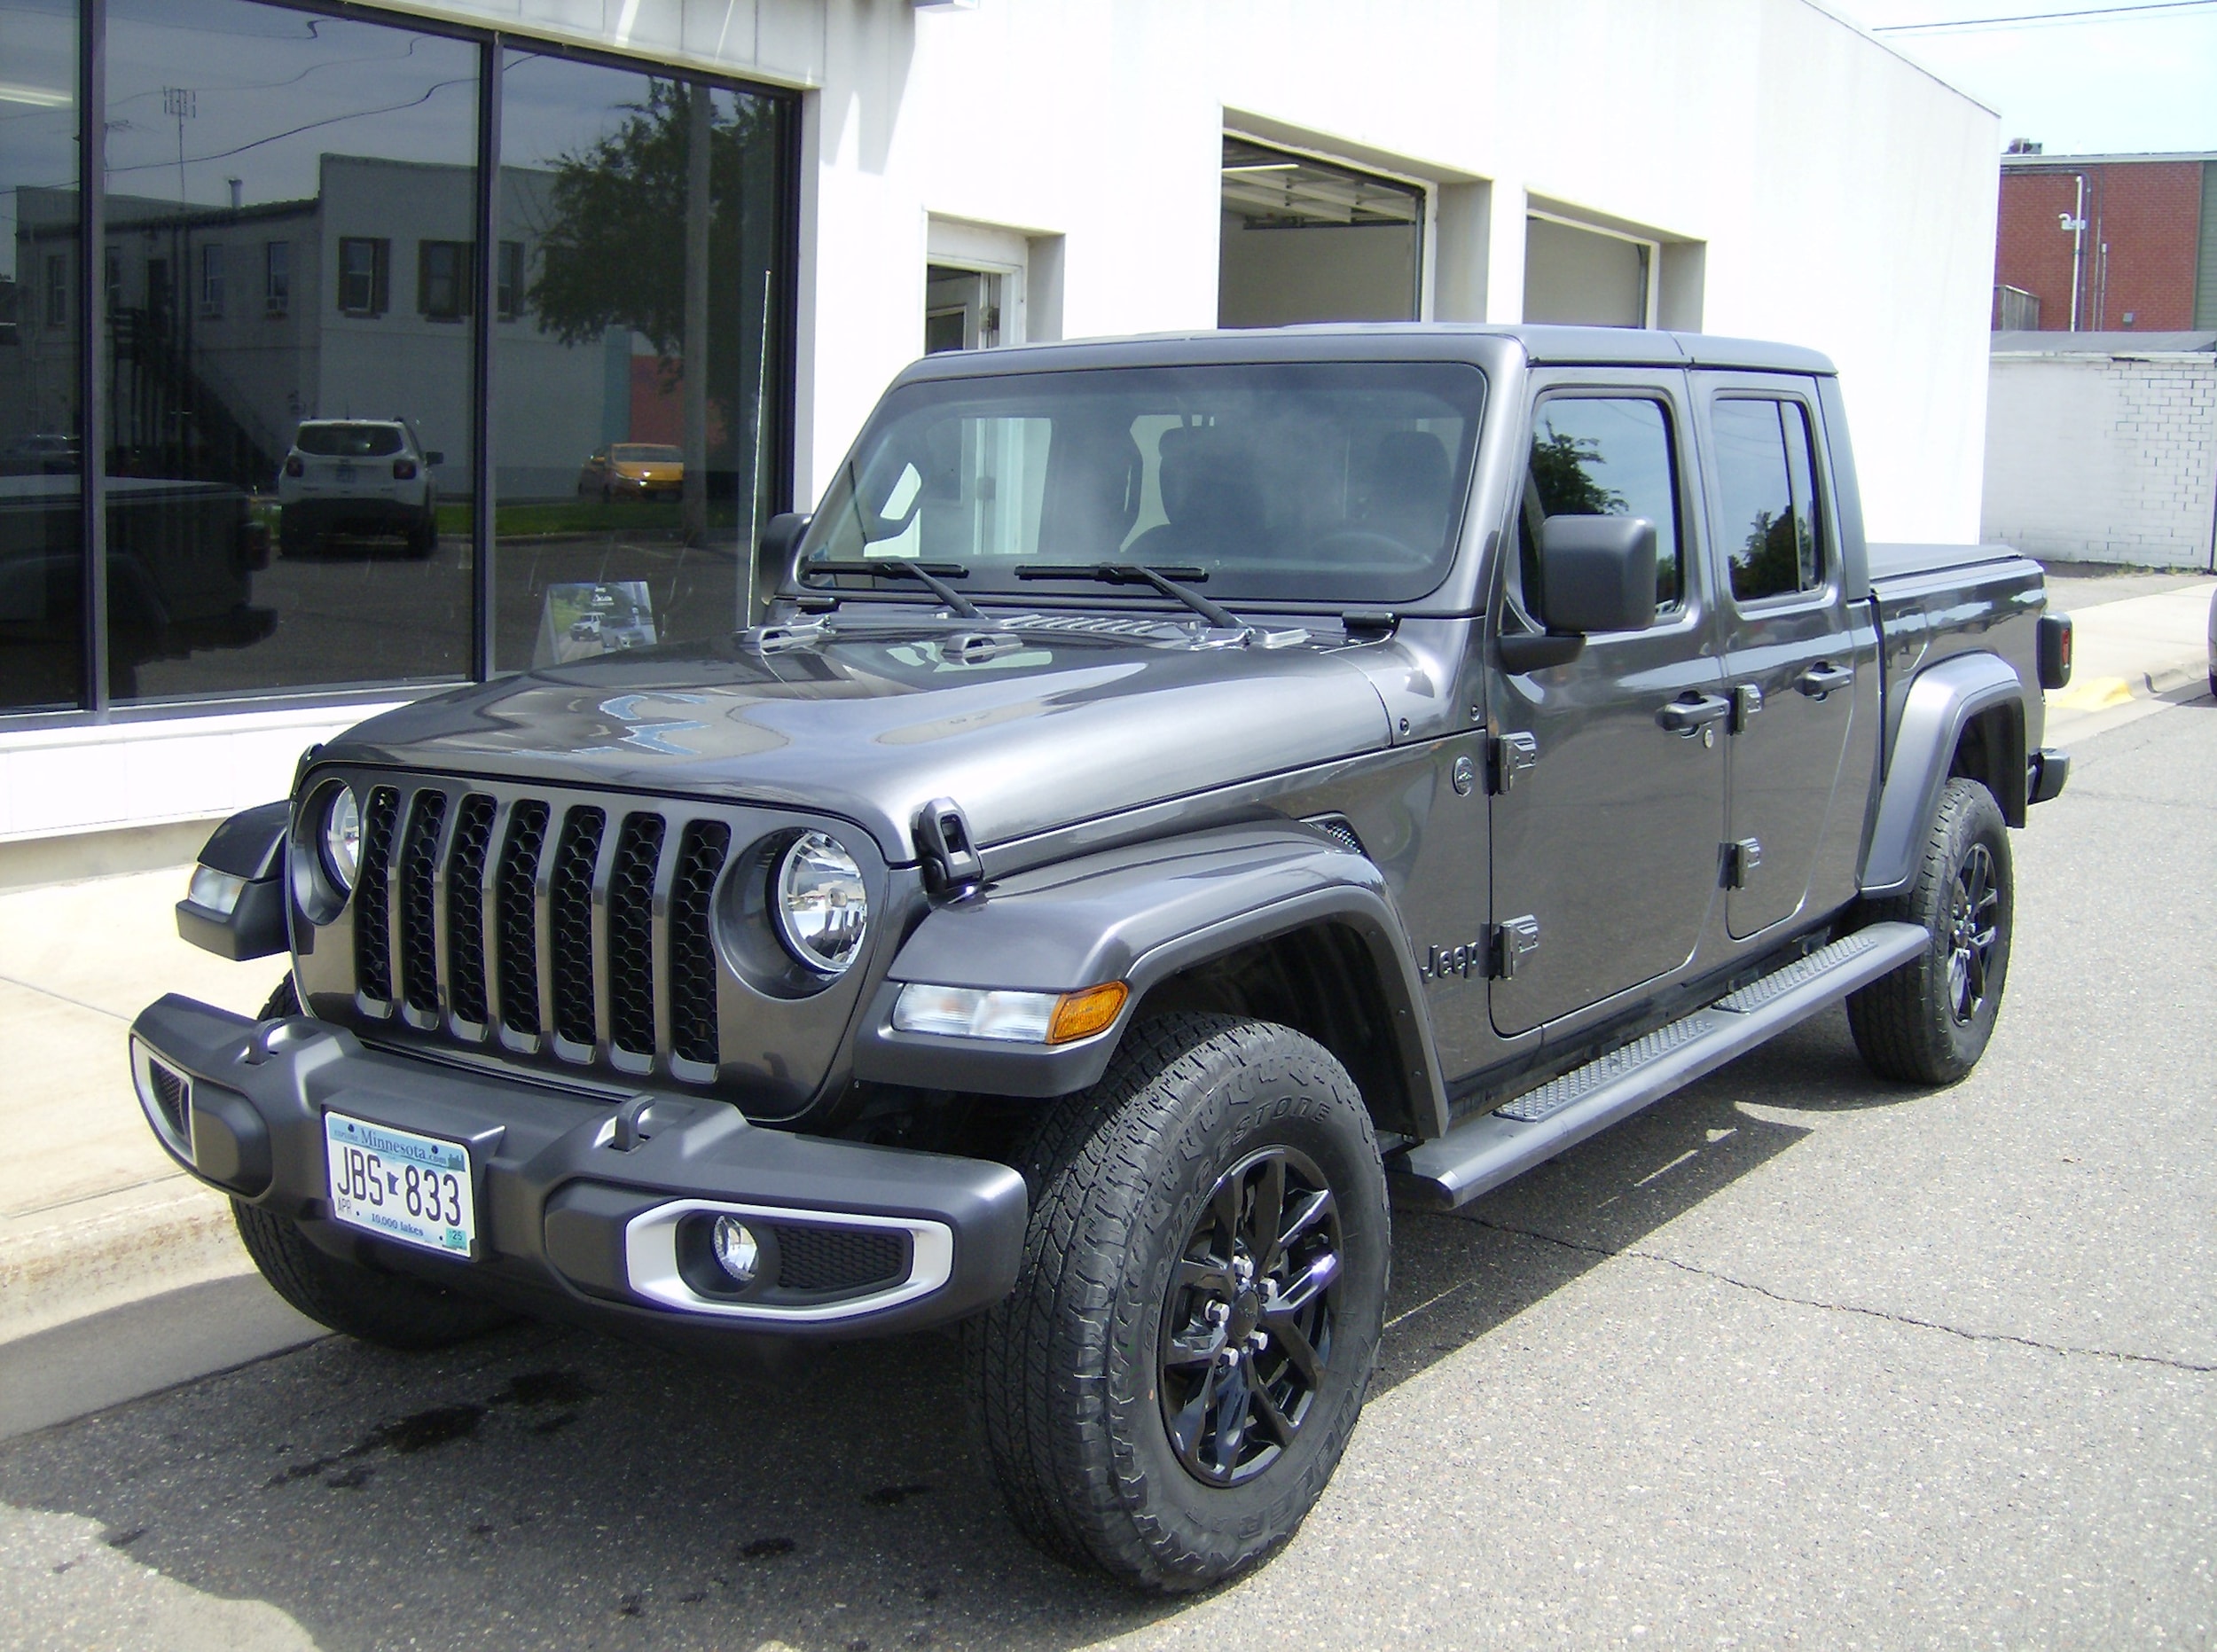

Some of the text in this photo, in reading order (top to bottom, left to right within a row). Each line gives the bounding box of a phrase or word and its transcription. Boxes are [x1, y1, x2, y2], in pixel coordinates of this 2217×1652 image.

[1419, 941, 1478, 984] Jeep
[337, 1146, 462, 1227] JBS 833
[337, 1196, 352, 1215] APR
[371, 1212, 425, 1237] 10,000 lakes
